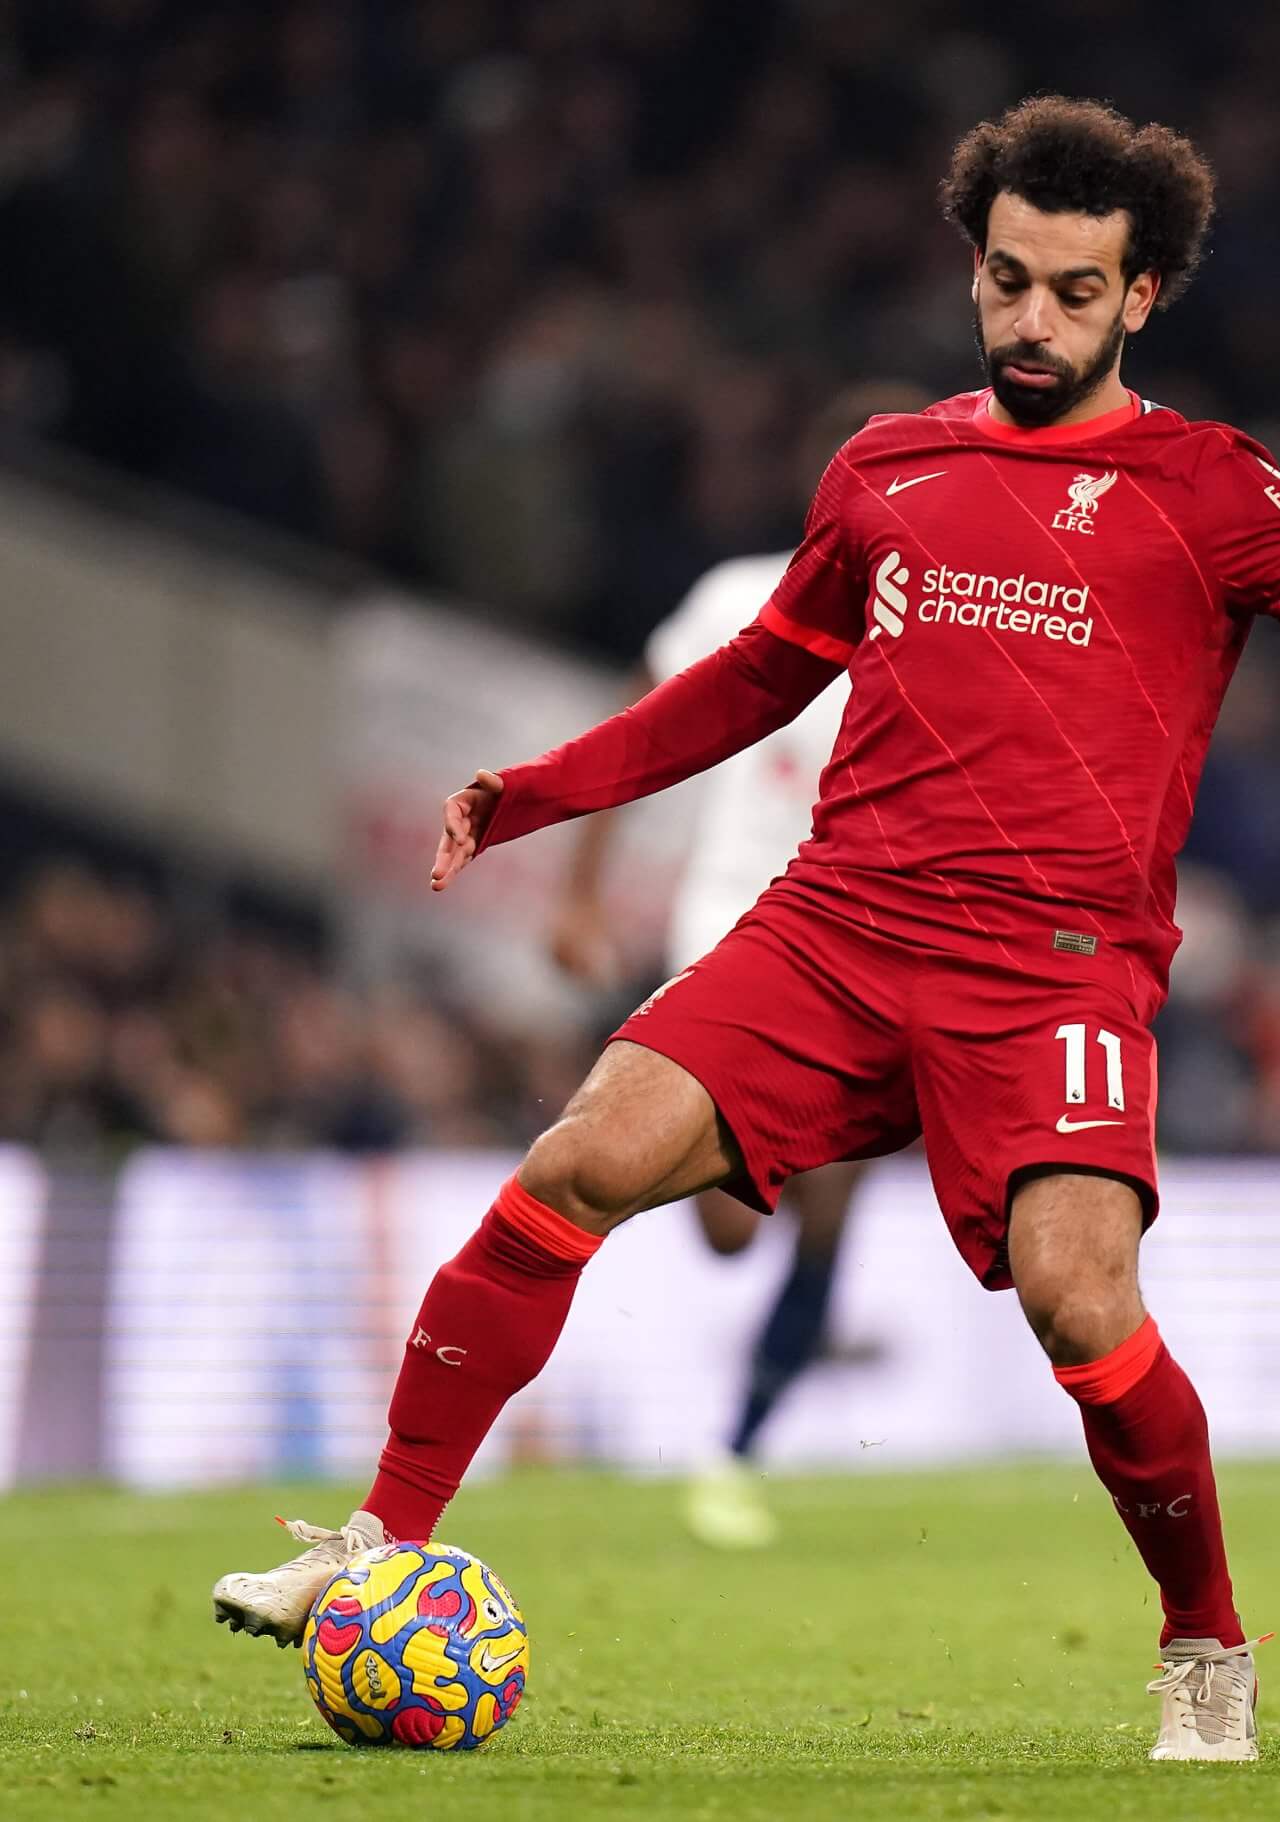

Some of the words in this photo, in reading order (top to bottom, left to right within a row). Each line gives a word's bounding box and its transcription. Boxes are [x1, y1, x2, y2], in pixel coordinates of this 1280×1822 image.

[921, 564, 1090, 615] standard
[917, 597, 1094, 648] chartered
[1055, 1023, 1125, 1112] 11
